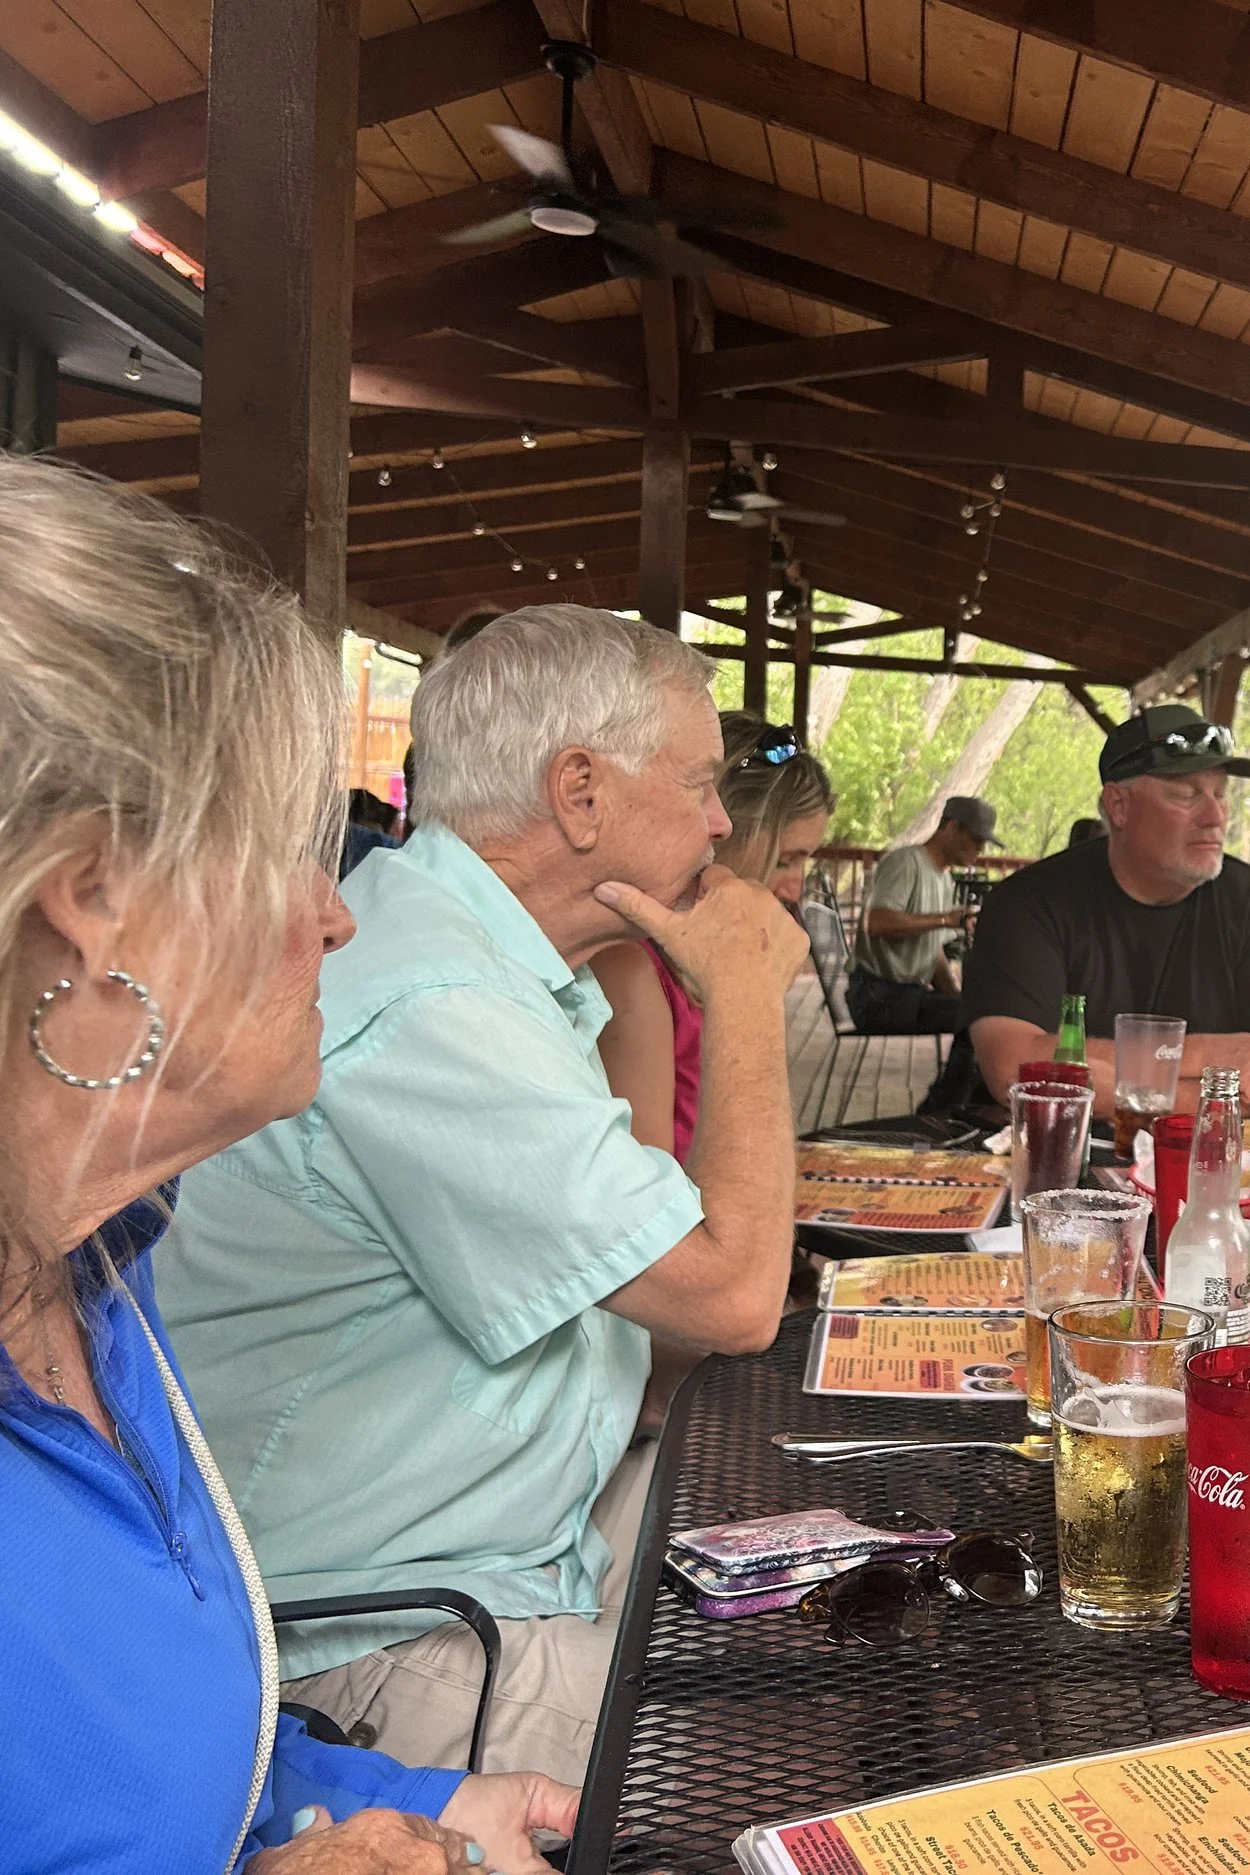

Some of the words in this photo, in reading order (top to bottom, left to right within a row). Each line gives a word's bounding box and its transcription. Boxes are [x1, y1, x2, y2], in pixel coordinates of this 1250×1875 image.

[983, 1809, 1009, 1831] Tacos
[1055, 1789, 1143, 1864] TACOS
[1044, 1802, 1071, 1824] Tacos
[1071, 1833, 1100, 1856] Asada
[922, 1835, 949, 1859] Street
[940, 1858, 961, 1875] Tac
[1196, 1835, 1241, 1875] Enchiladas
[886, 1858, 904, 1875] Lengu
[909, 1858, 930, 1875] guaca
[929, 1865, 944, 1875] tor
[995, 1866, 1011, 1875] an
[1010, 1866, 1025, 1875] ric
[1184, 1867, 1197, 1875] avo
